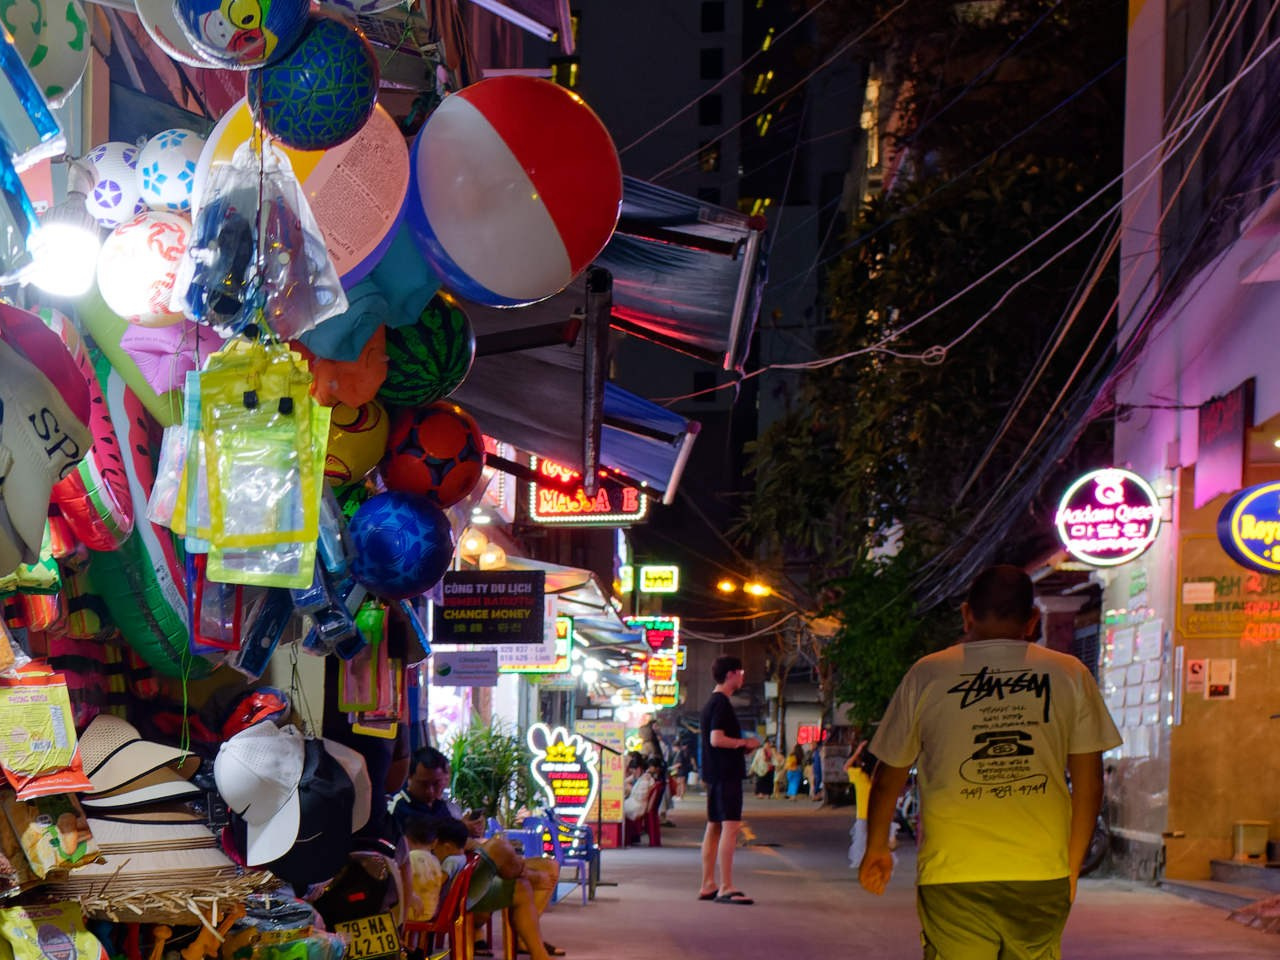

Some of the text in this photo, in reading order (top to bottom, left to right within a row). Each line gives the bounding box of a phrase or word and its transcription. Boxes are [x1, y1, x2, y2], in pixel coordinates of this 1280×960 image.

[1241, 514, 1280, 545] Roy
[443, 609, 532, 620] CHANGE MONEY
